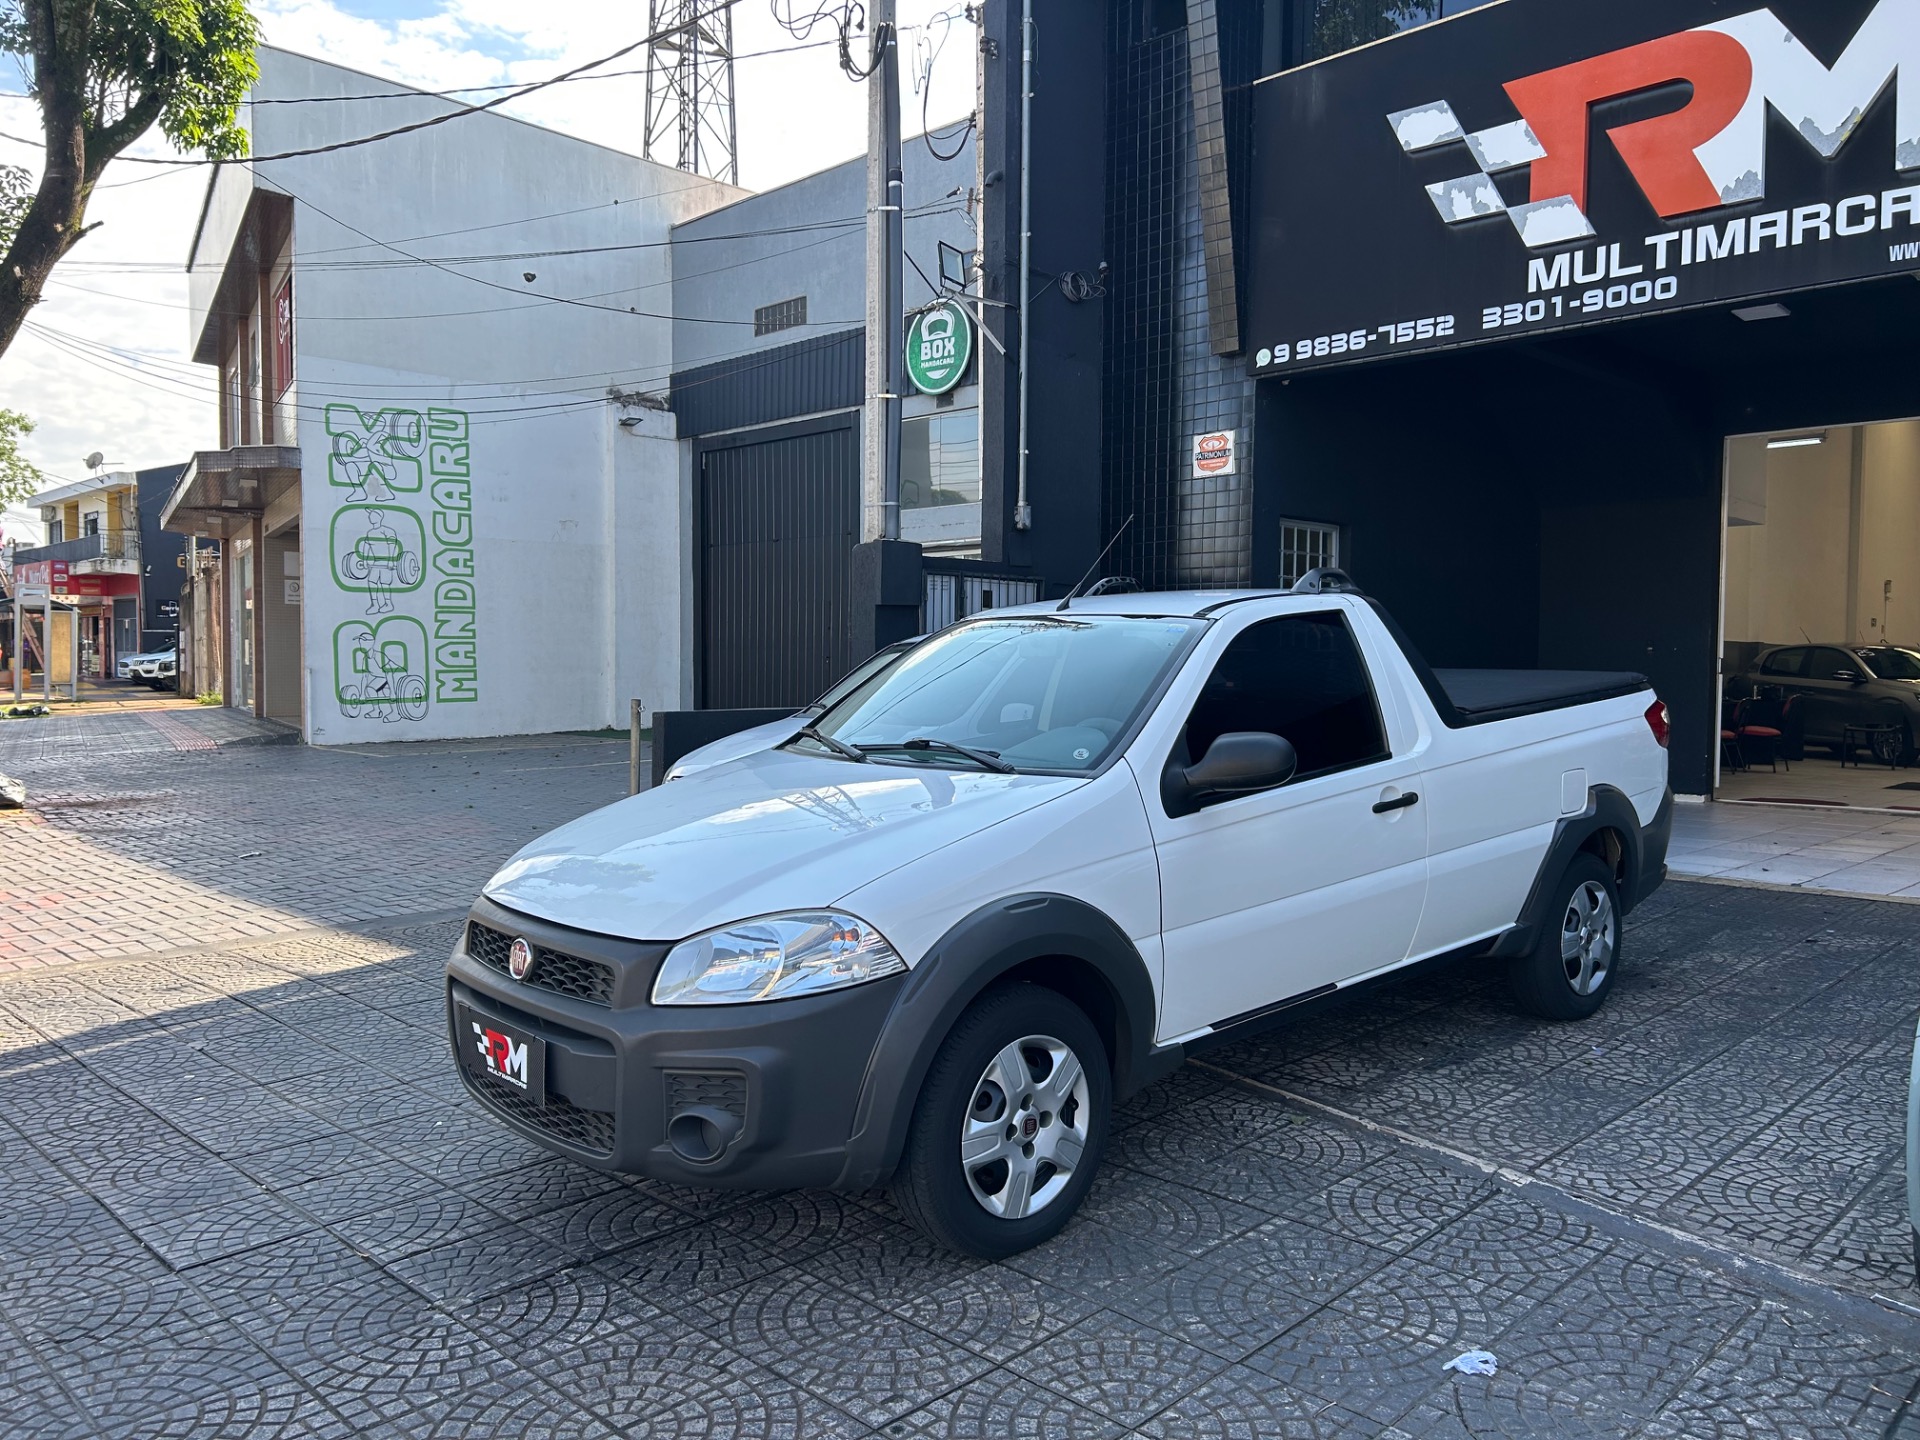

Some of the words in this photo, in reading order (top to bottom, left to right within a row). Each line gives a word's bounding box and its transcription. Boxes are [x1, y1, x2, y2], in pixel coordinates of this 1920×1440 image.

[1526, 185, 1920, 293] MULTIMARCA
[920, 337, 955, 361] BOX
[1273, 343, 1291, 365] 9
[1296, 314, 1455, 361] 9836-7552
[1482, 275, 1678, 330] 3301-9000
[325, 403, 430, 704] BOX
[427, 406, 478, 703] MANDACARU
[485, 1027, 528, 1084] RM
